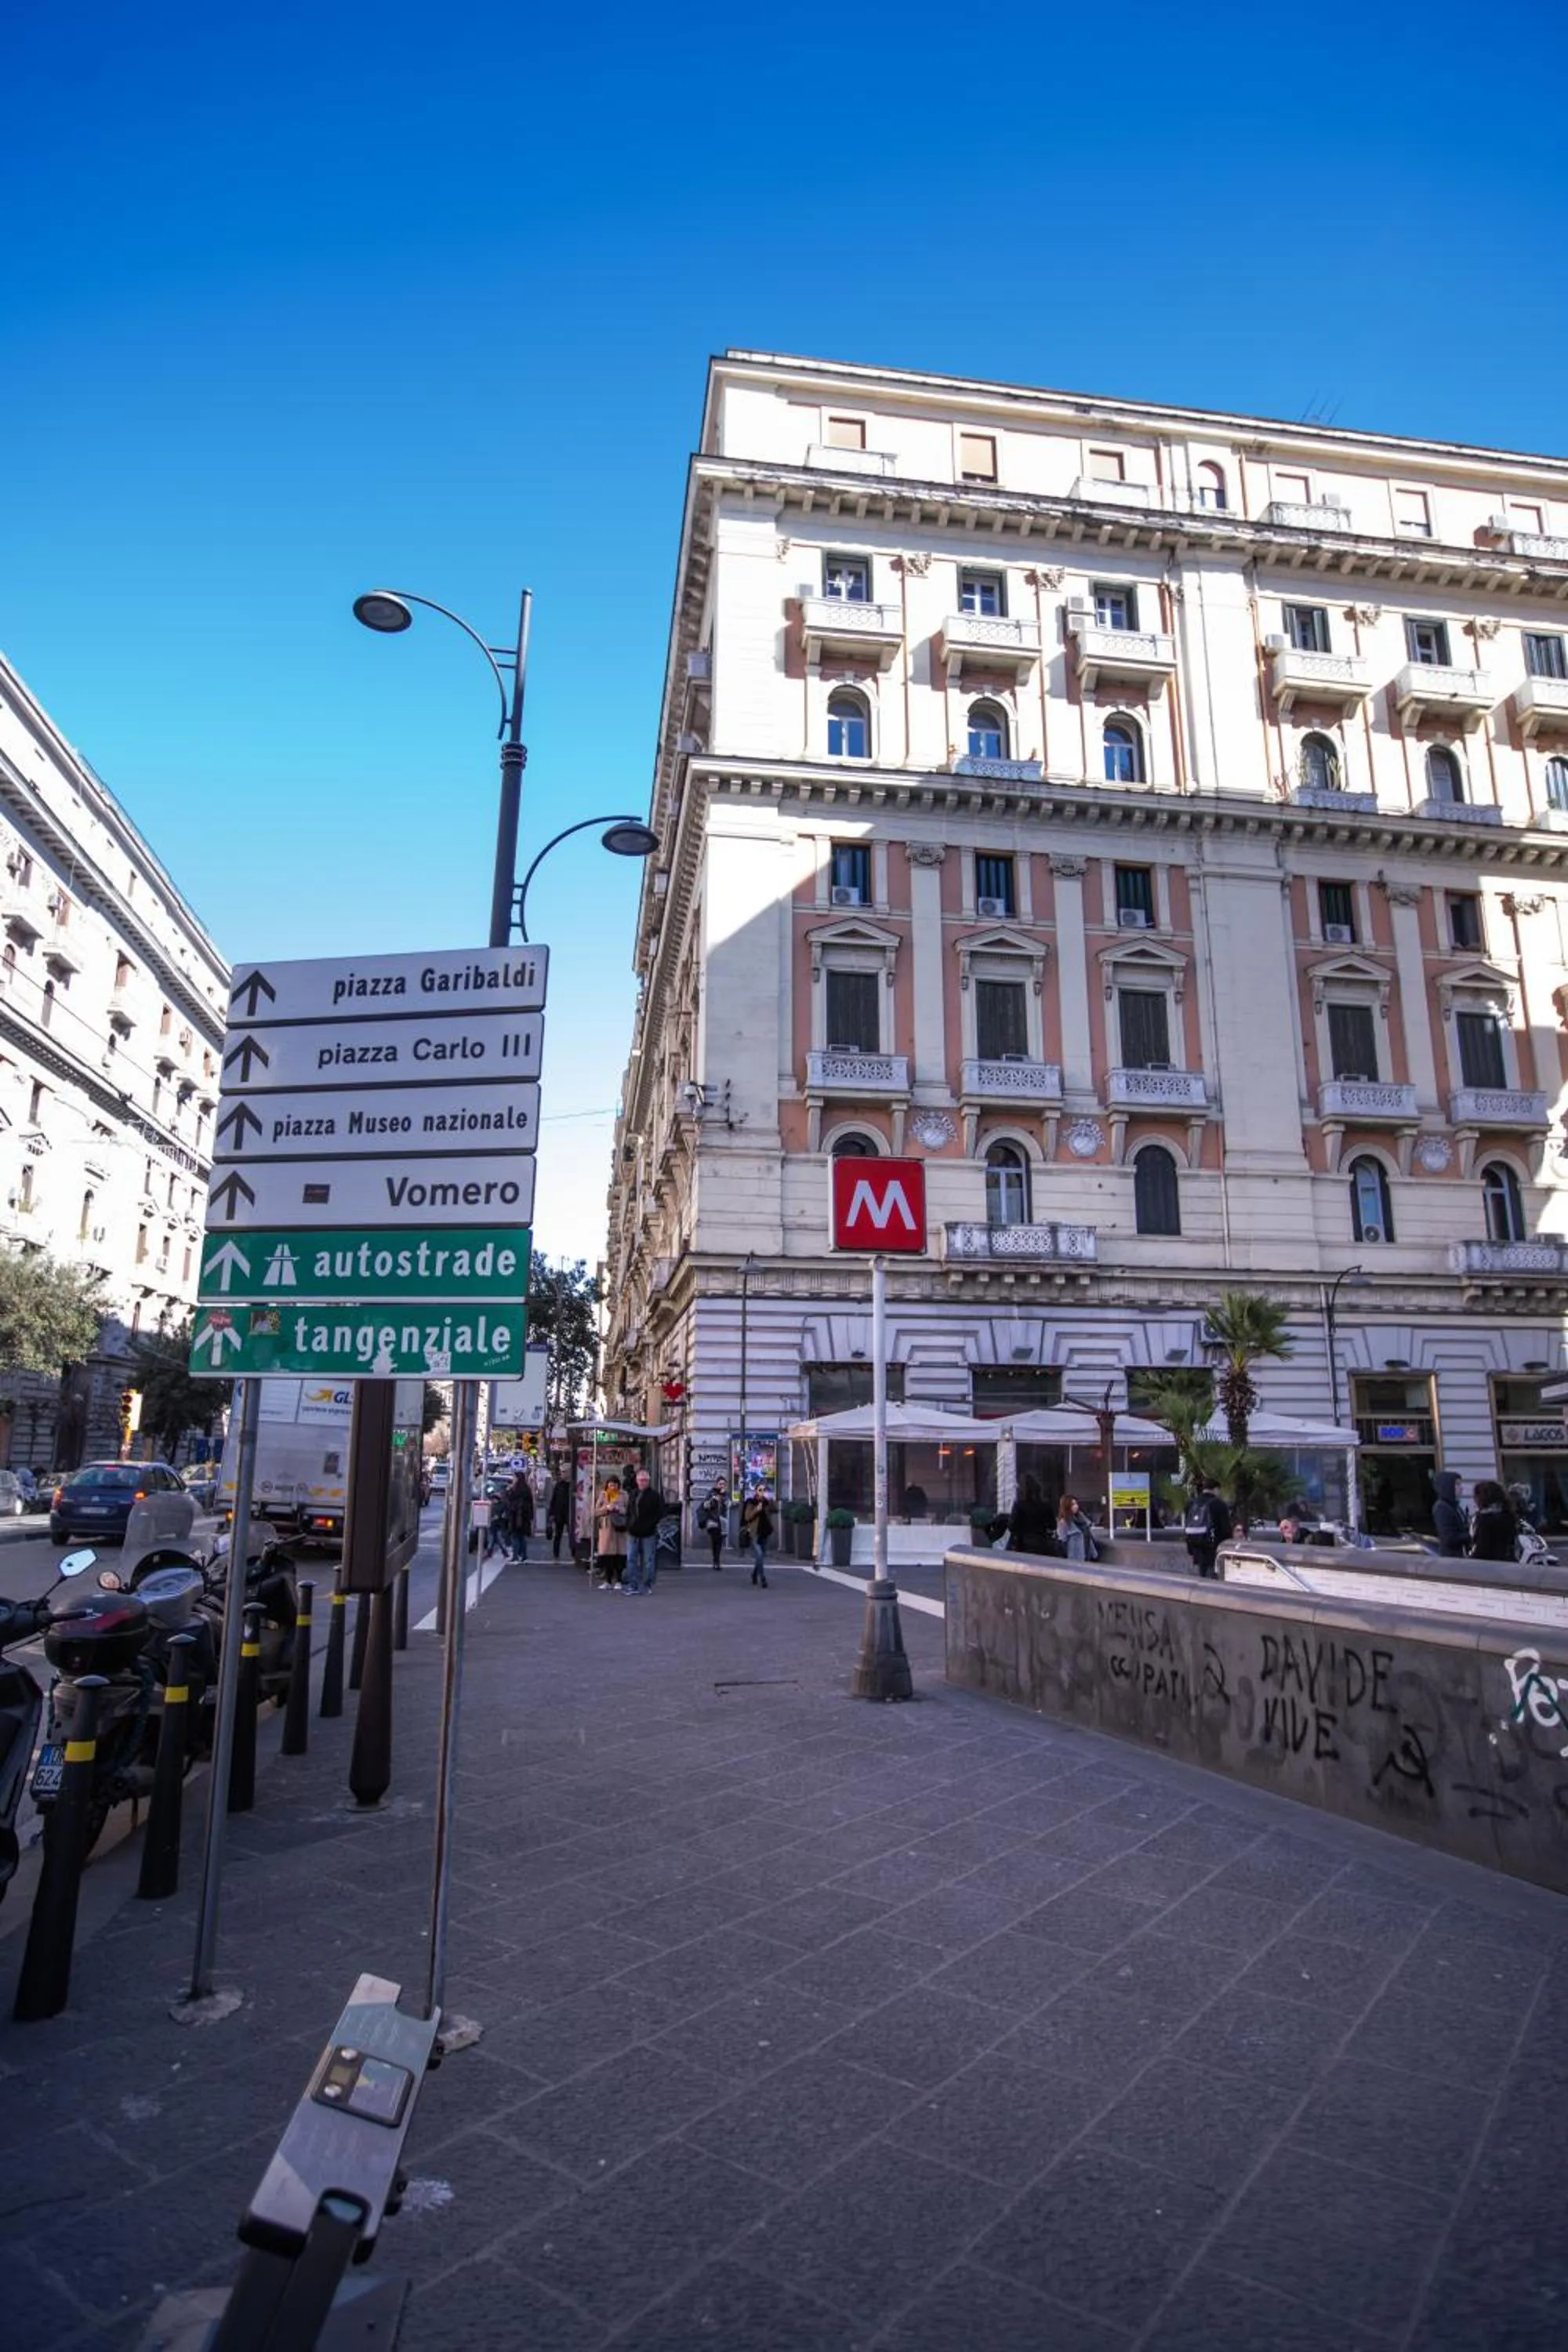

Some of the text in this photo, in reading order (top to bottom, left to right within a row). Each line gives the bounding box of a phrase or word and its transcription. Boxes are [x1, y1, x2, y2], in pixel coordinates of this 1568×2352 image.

[333, 963, 536, 1004] piazza Garibaldi
[318, 1033, 531, 1069] piazza Carlo III
[273, 1106, 528, 1142] piazza Museo nazionale
[386, 1176, 520, 1207] Vomero
[314, 1241, 517, 1278] autostrade
[294, 1315, 511, 1362] tangenziale
[1261, 1633, 1398, 1715] DAVIDE
[1264, 1697, 1340, 1761] VIVE
